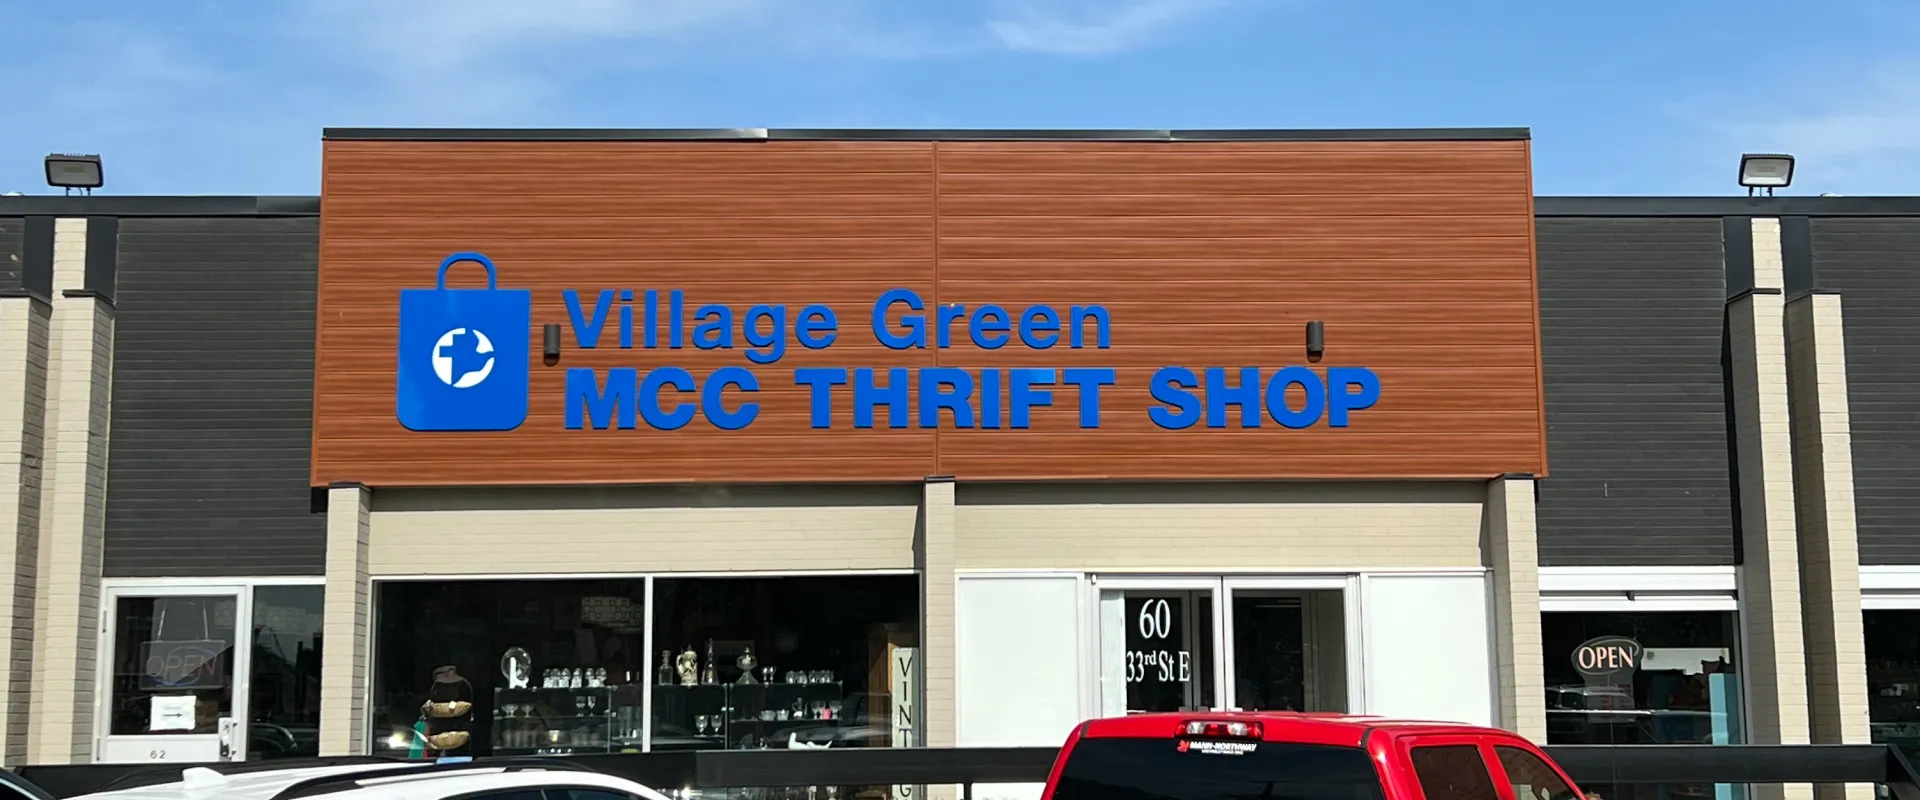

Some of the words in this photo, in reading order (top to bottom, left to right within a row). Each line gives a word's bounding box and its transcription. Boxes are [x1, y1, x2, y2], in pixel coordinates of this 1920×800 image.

[562, 288, 838, 363] Village
[871, 288, 1112, 350] Green
[564, 366, 760, 430] MCC
[794, 366, 1116, 430] THRIFT
[1147, 365, 1382, 430] SHOP
[1139, 599, 1171, 639] 60
[146, 655, 216, 680] OPEN
[1126, 650, 1157, 682] 33rd
[1158, 650, 1175, 682] St
[1178, 650, 1190, 682] E
[1579, 646, 1634, 669] OPEN
[150, 750, 166, 759] 62
